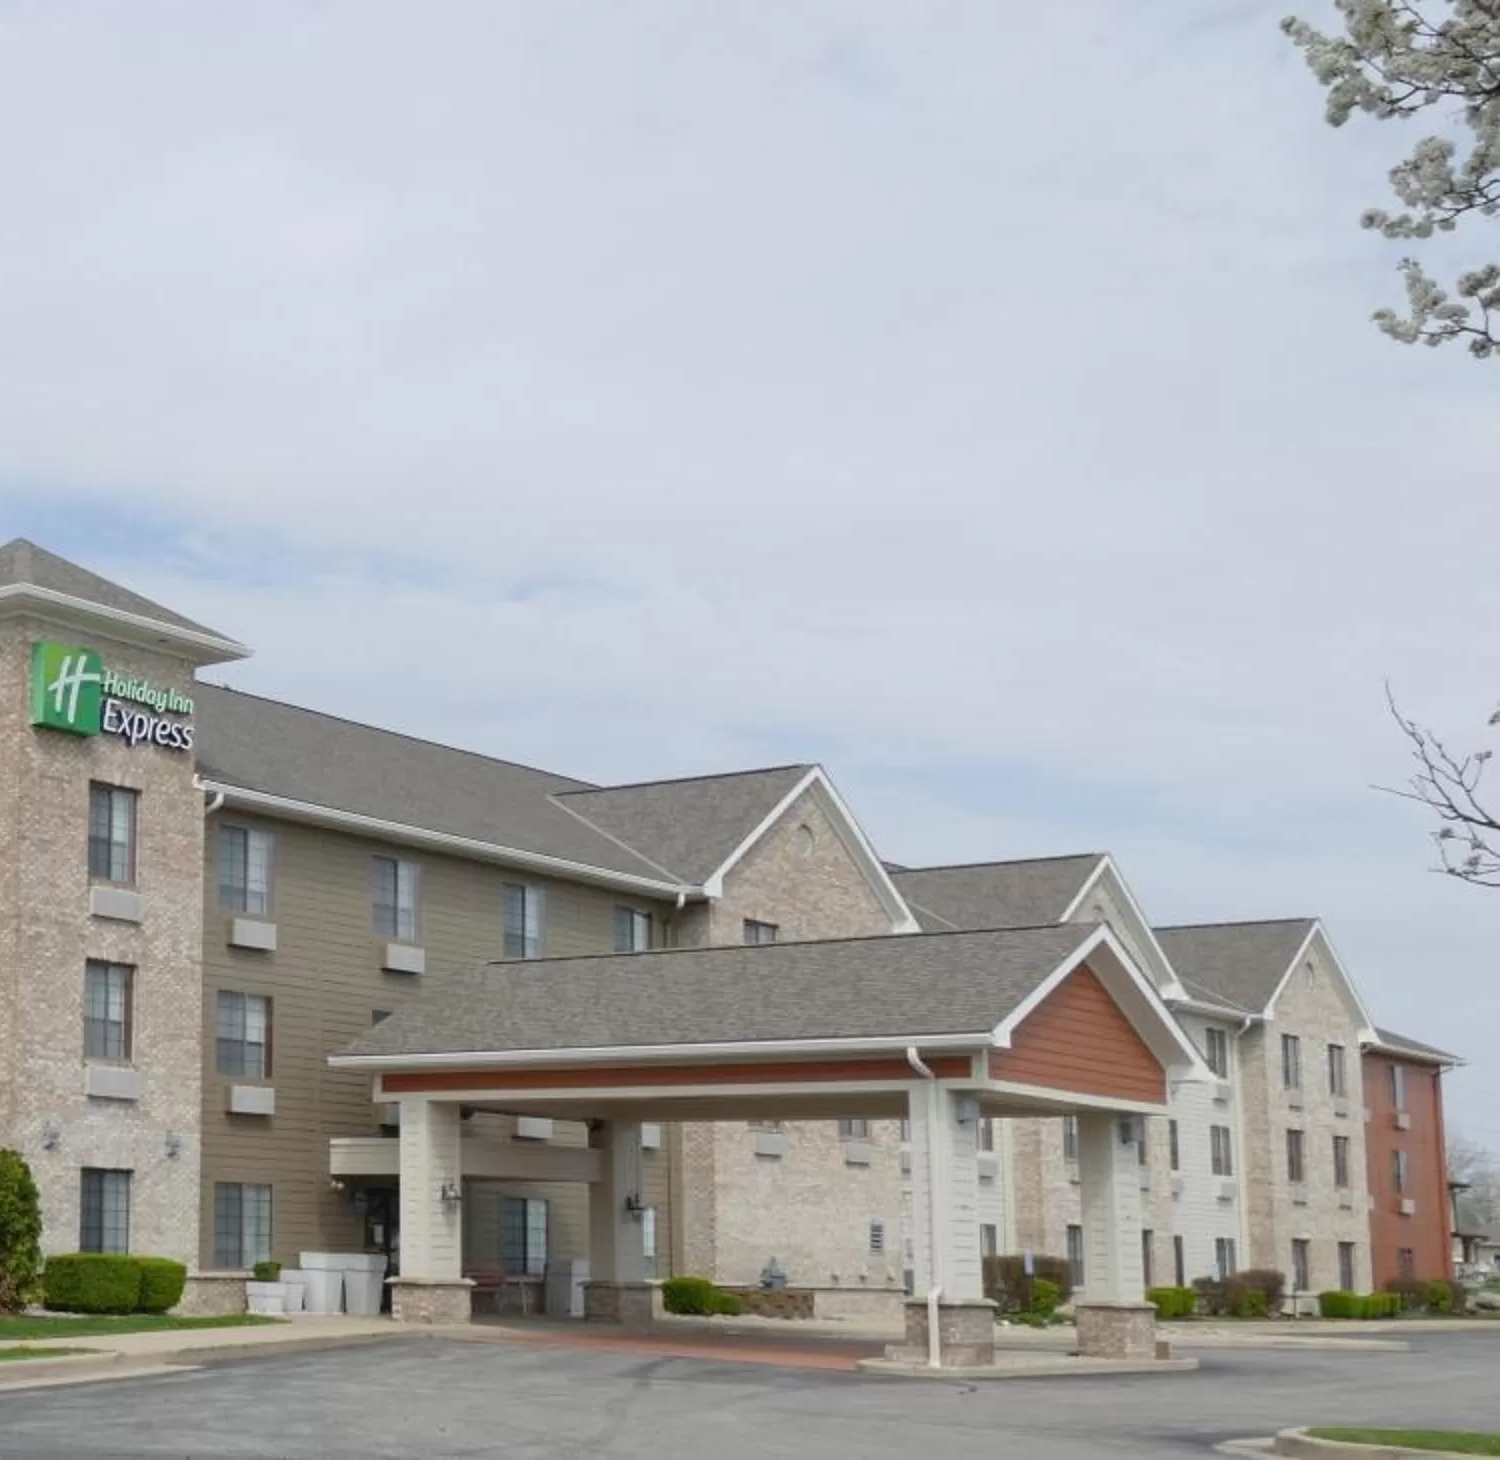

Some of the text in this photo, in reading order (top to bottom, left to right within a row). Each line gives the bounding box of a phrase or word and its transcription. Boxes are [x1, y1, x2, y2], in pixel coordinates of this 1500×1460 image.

[48, 655, 100, 724] H
[103, 670, 195, 713] Holiday Inn
[103, 698, 195, 750] Express
